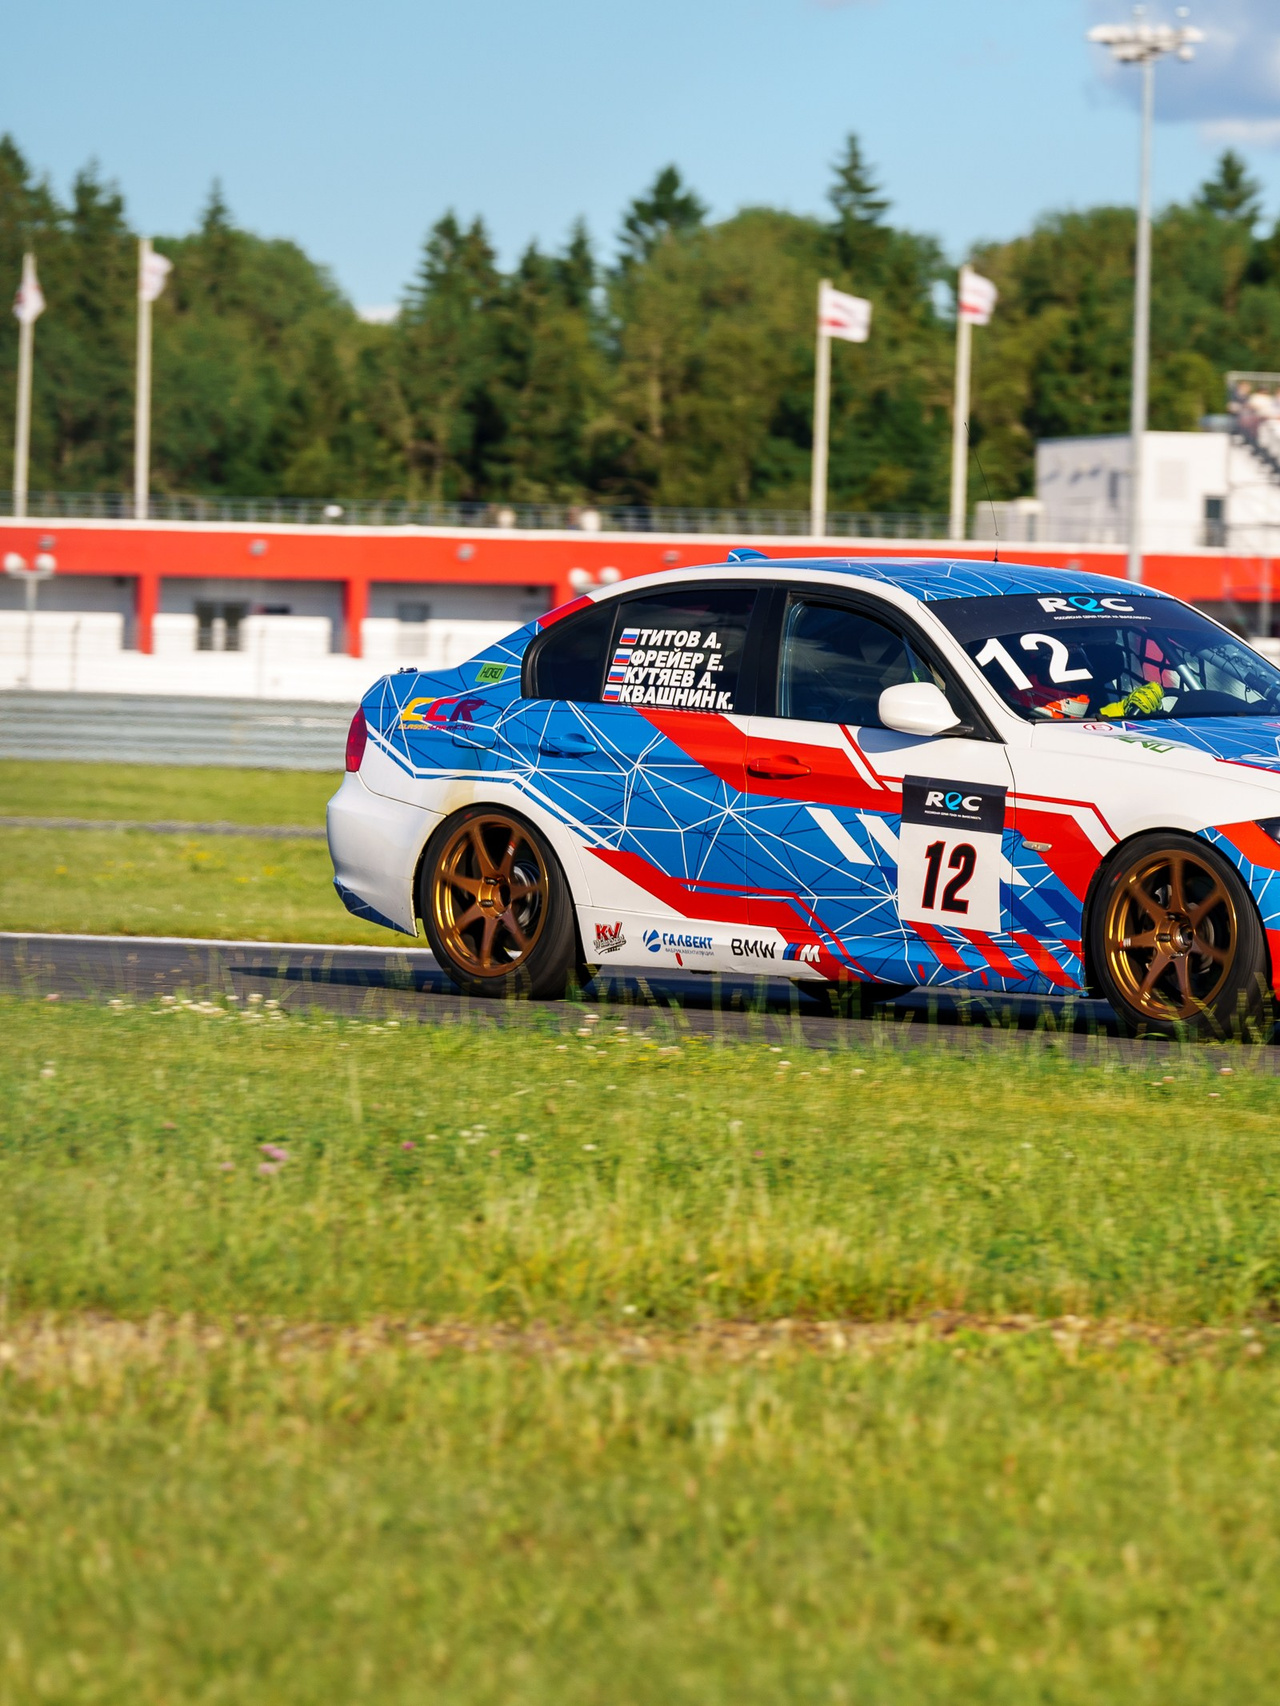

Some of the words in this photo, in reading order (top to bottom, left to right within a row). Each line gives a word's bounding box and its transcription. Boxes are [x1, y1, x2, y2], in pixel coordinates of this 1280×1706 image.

[640, 629, 702, 648] ТИТОВ
[702, 632, 722, 649] А.
[630, 648, 704, 670] ФРЕЙЕР
[706, 653, 724, 671] Е.
[975, 633, 1093, 690] 12
[480, 667, 503, 679] HOGO
[623, 666, 695, 688] КУТЯЕВ
[697, 672, 716, 689] А.
[619, 684, 716, 708] КВАШНИН
[715, 691, 734, 710] К.
[401, 697, 487, 722] CCR
[921, 840, 978, 914] 12
[595, 921, 622, 941] KV
[662, 933, 713, 949] ГАЛВЕНТ
[731, 938, 776, 959] BMW
[799, 944, 821, 962] M
